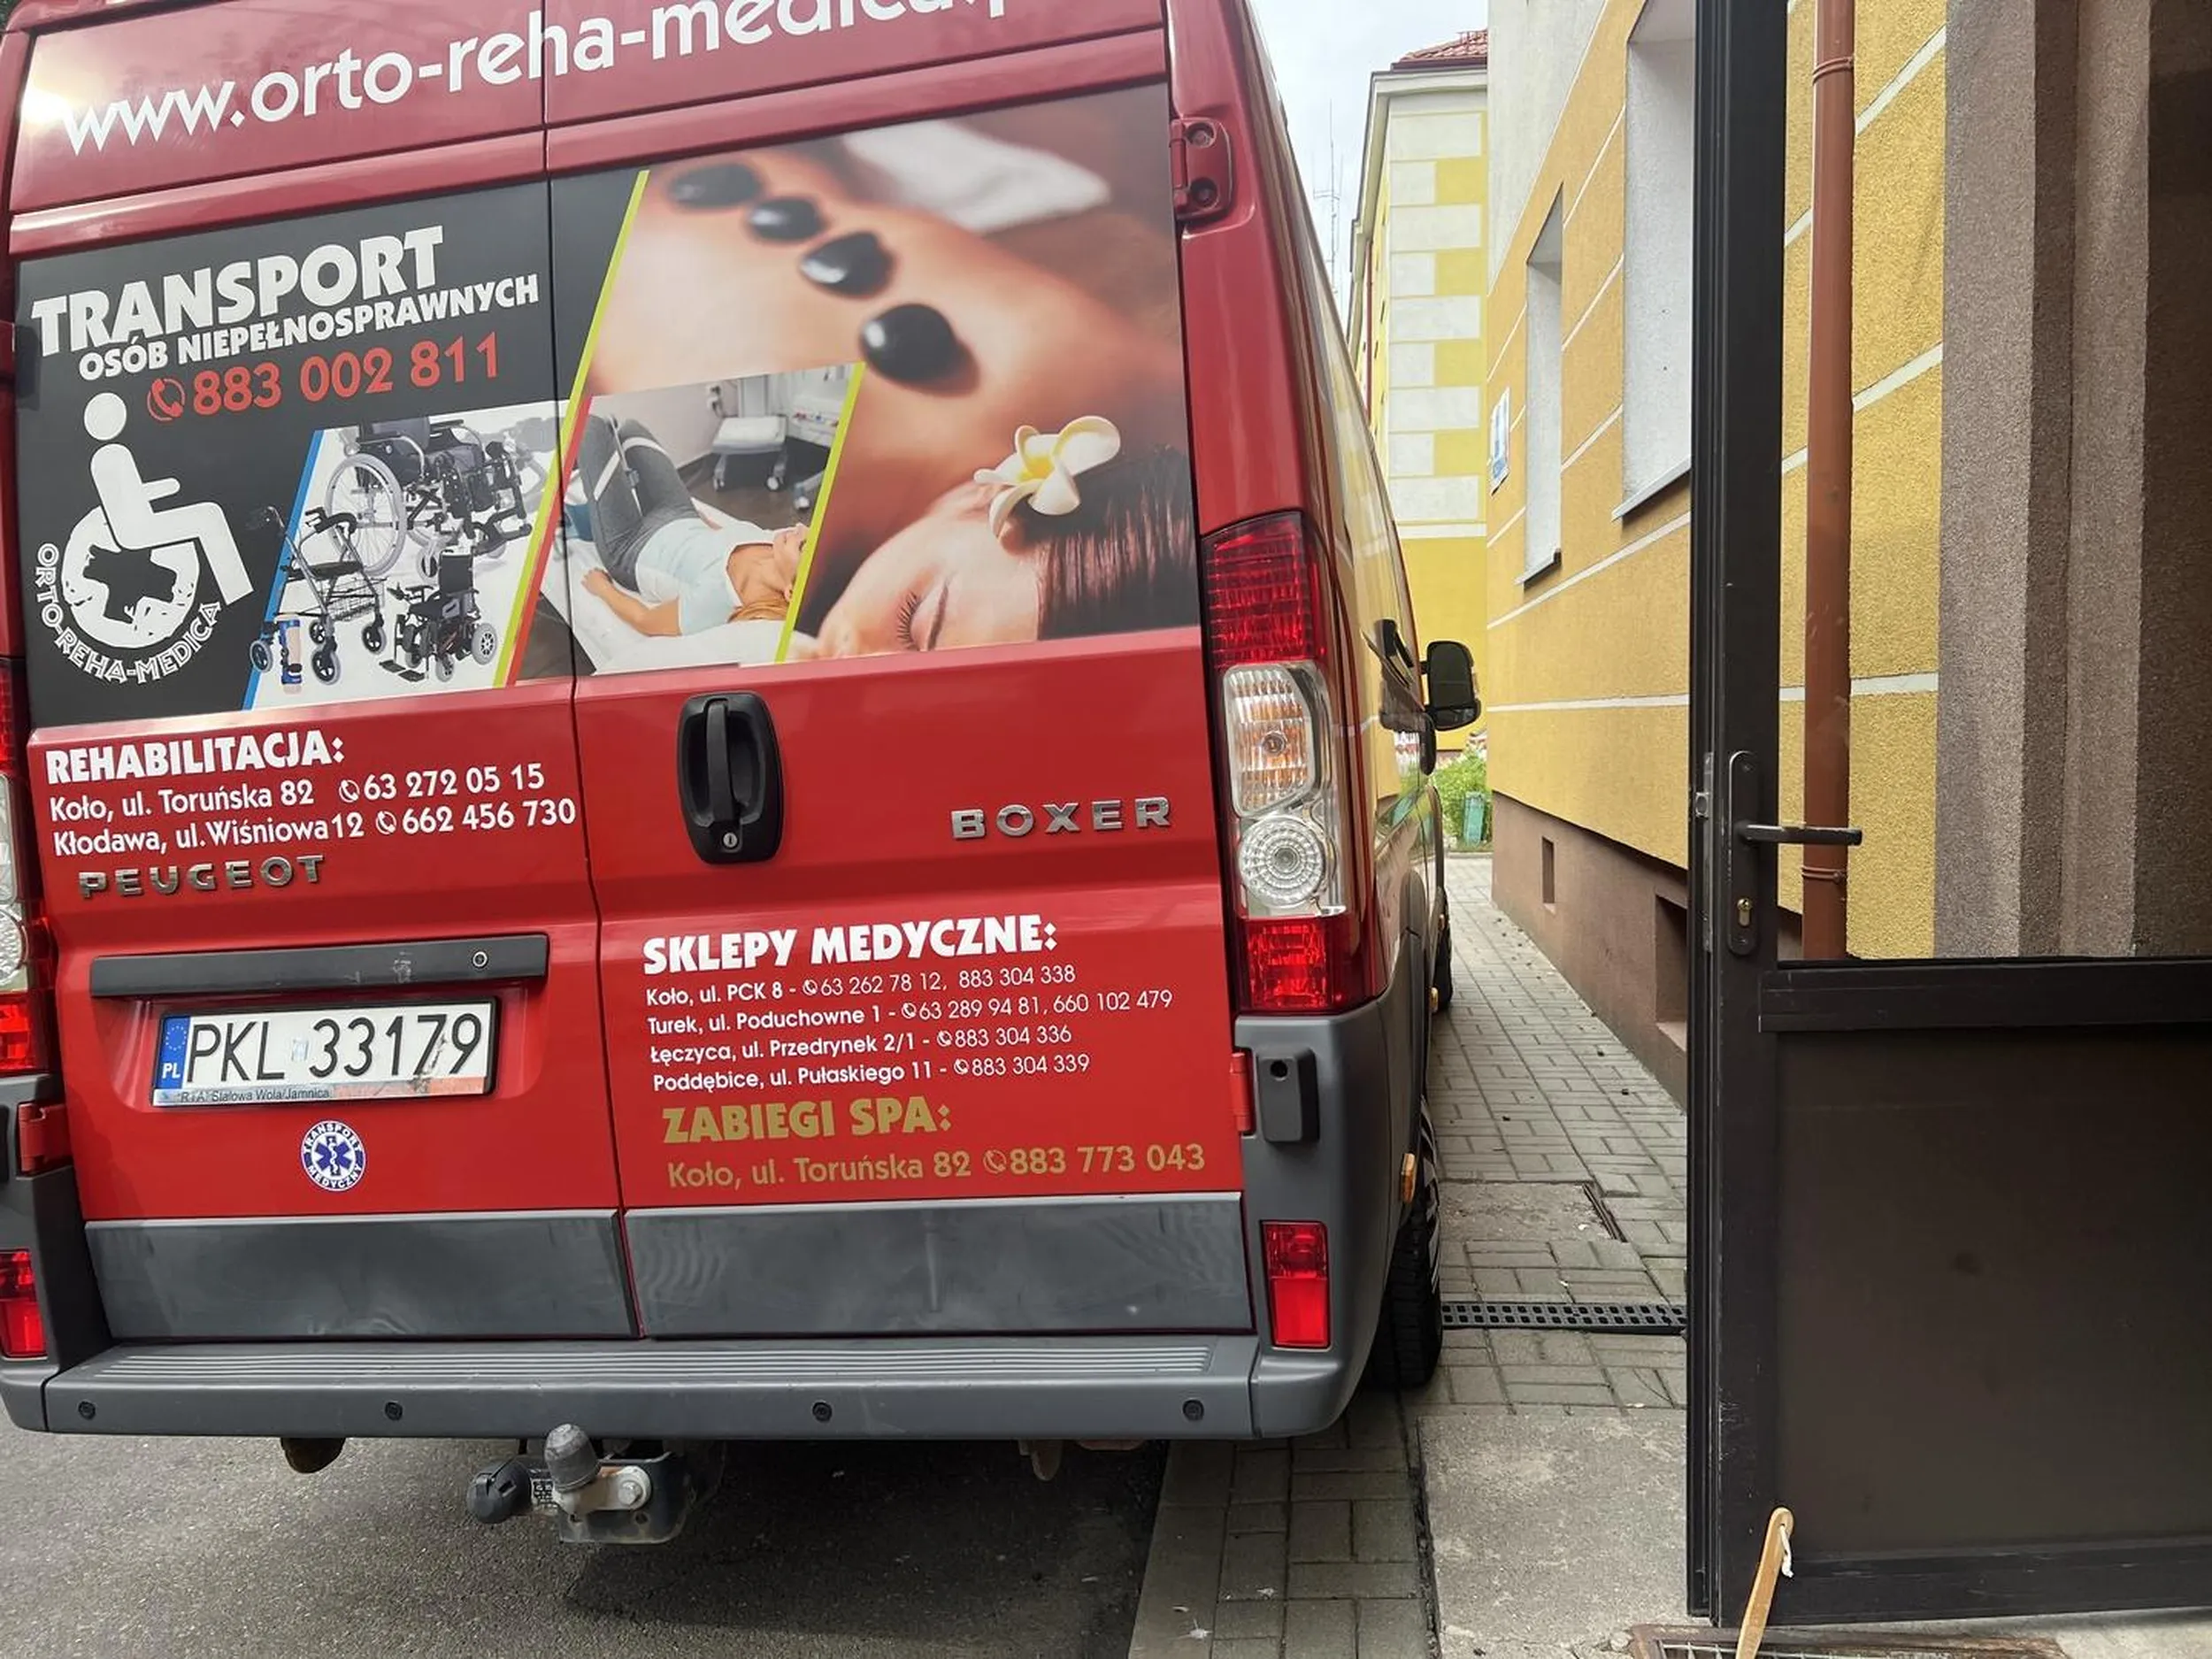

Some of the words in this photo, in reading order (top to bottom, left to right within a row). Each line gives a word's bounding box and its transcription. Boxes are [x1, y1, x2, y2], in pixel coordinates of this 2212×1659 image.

[31, 225, 443, 357] TRANSPORT
[79, 336, 168, 380] OSÓB
[177, 273, 539, 365] NIEPEŁNOSPRAWNYCH
[193, 361, 282, 416] 883
[300, 347, 393, 403] 002
[411, 331, 497, 387] 811
[35, 543, 221, 684] ORTO-REHA-MEDICA
[46, 730, 344, 784] REHABILITACJA:
[50, 796, 113, 823] Koło,
[121, 791, 152, 817] ul.
[157, 783, 273, 814] Toruńska
[280, 779, 314, 806] 82
[364, 773, 397, 801] 63
[405, 769, 457, 798] 272
[465, 765, 501, 794] 05
[511, 763, 544, 790] 15
[52, 828, 167, 856] Kłodawa,
[175, 823, 205, 849] ul.
[331, 812, 365, 839] 12
[403, 806, 454, 834] 662
[462, 802, 515, 831] 456
[522, 798, 576, 827] 730
[951, 796, 1171, 840] BOXER
[78, 855, 325, 900] PEUGEOT
[642, 929, 797, 975] SKLEPY
[810, 914, 1058, 965] MEDYCZNE:
[646, 987, 694, 1007] Koło,
[699, 985, 721, 1004] ul.
[726, 983, 766, 1002] PCK
[772, 981, 783, 1000] 8
[821, 977, 842, 996] 63
[849, 975, 883, 995] 262
[889, 973, 912, 992] 78
[919, 972, 947, 992] 12,
[959, 970, 994, 989] 883
[1000, 967, 1034, 987] 304
[1041, 964, 1076, 984] 338
[648, 1016, 703, 1036] Turek,
[709, 1013, 731, 1033] ul.
[736, 1007, 865, 1030] Poduchowne
[872, 1005, 880, 1024] 1
[919, 1001, 942, 1020] 63
[948, 999, 982, 1018] 289
[987, 998, 1012, 1017] 94
[1018, 995, 1048, 1016] 81,
[1053, 994, 1089, 1013] 660
[1096, 992, 1131, 1011] 102
[1136, 989, 1173, 1009] 479
[186, 1020, 286, 1083] PKL
[309, 1012, 483, 1078] 33179
[650, 1045, 736, 1067] Łęczyca,
[742, 1040, 764, 1059] ul.
[770, 1034, 878, 1058] Przedrynek
[884, 1033, 915, 1054] 2/1
[955, 1028, 989, 1048] 883
[995, 1026, 1030, 1046] 304
[1036, 1025, 1071, 1044] 336
[162, 1063, 180, 1079] PL
[653, 1071, 764, 1094] Poddębice,
[770, 1068, 792, 1087] ul.
[798, 1064, 905, 1086] Pułaskiego
[911, 1061, 932, 1079] 11
[972, 1057, 1006, 1077] 883
[1012, 1055, 1048, 1075] 304
[1053, 1053, 1090, 1073] 339
[303, 1122, 363, 1154] TRANSPORT
[663, 1100, 836, 1144] ZABIEGI
[849, 1095, 951, 1136] SPA:
[307, 1163, 363, 1188] MEDYCZNY
[668, 1160, 741, 1191] Koło,
[752, 1158, 785, 1185] ul.
[793, 1153, 923, 1182] Toruńska
[933, 1150, 972, 1178] 82
[1010, 1147, 1066, 1175] 883
[1077, 1145, 1135, 1173] 773
[1146, 1142, 1205, 1171] 043
